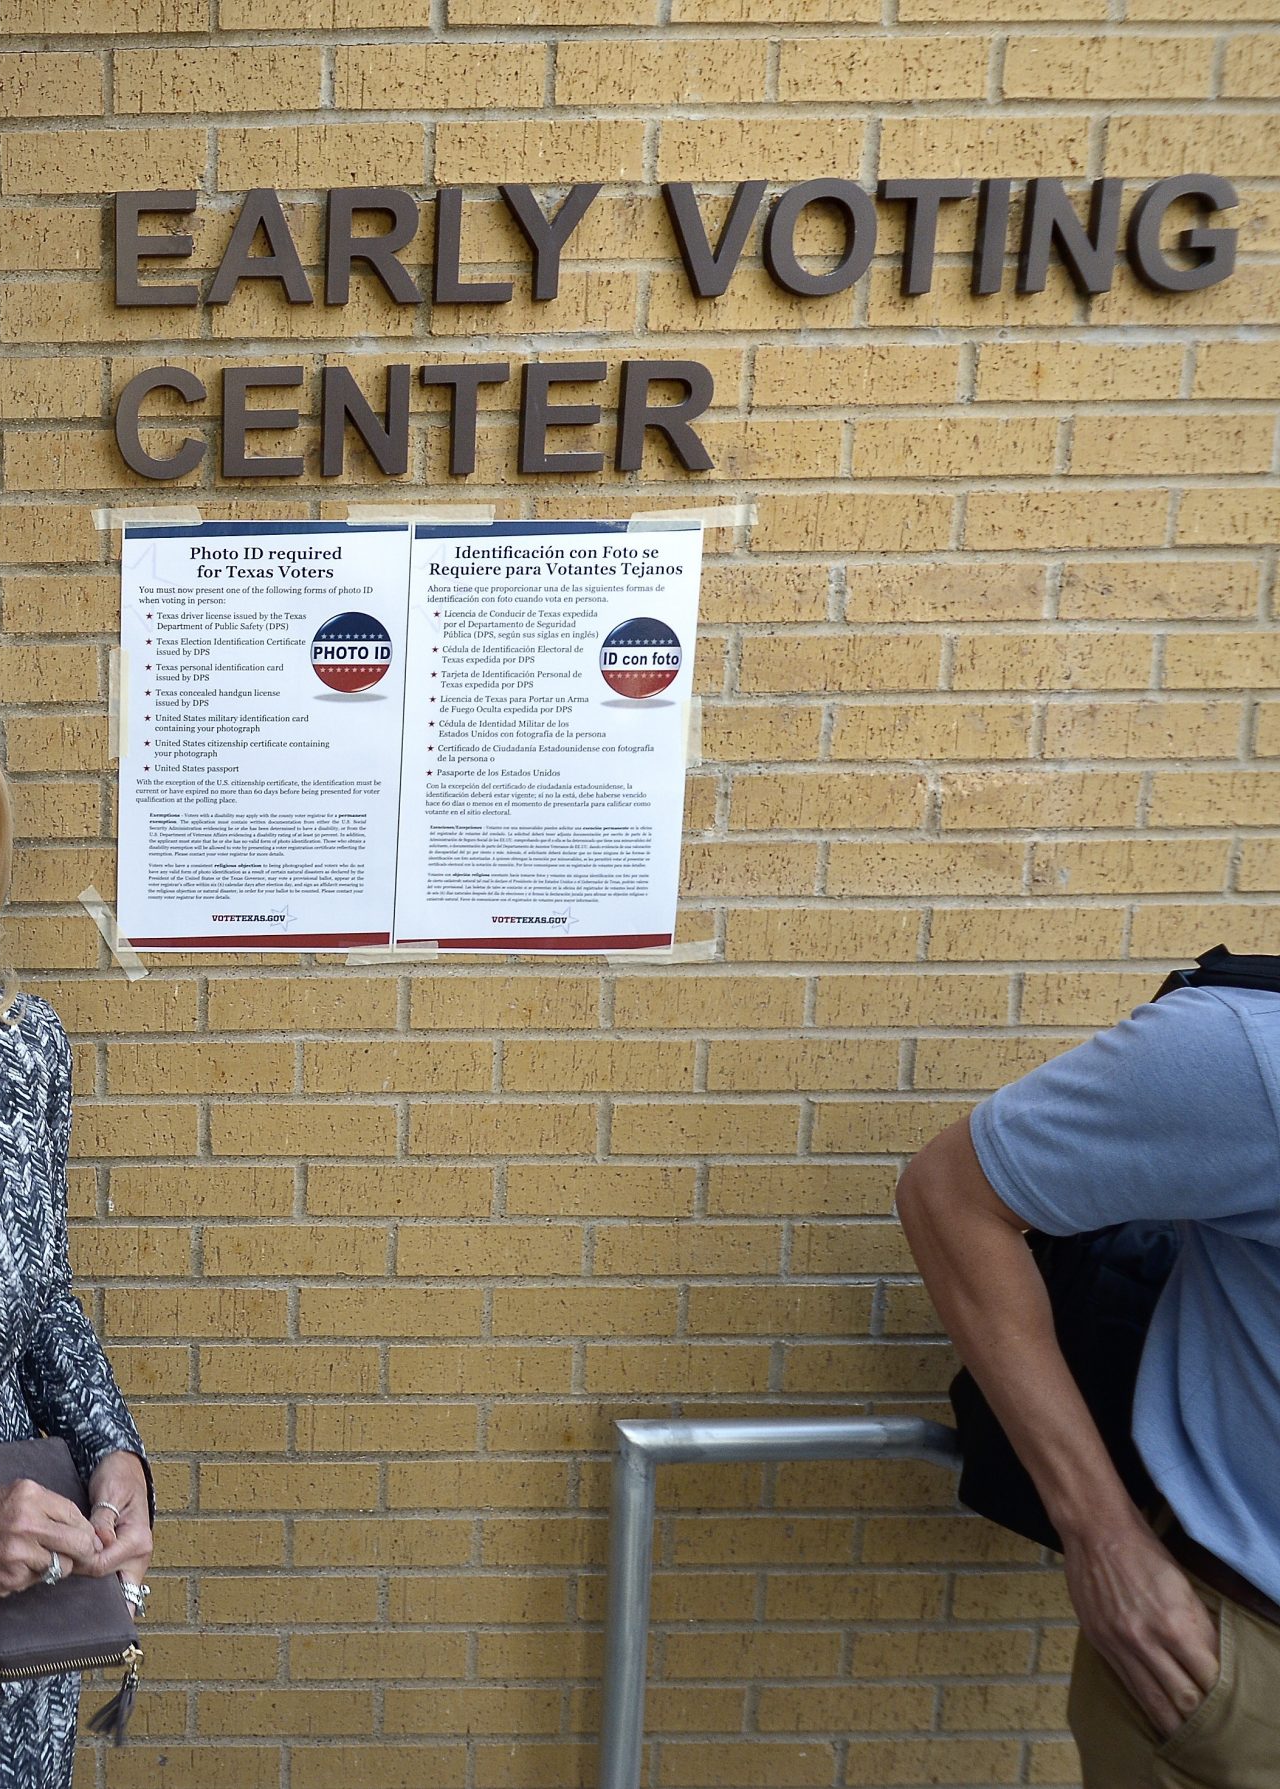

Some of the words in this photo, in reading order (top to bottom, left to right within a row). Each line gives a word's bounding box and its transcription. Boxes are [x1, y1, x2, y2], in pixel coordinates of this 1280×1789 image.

[116, 183, 604, 305] EARLY
[662, 173, 1240, 297] VOTING
[116, 361, 715, 479] CENTER
[189, 546, 239, 560] Photo
[243, 547, 264, 560] ID
[268, 546, 342, 563] required
[454, 545, 564, 559] Identificación
[569, 549, 597, 559] con
[602, 546, 638, 559] Foto
[642, 549, 659, 559] se
[197, 565, 222, 578] for
[225, 565, 274, 578] Texas
[277, 565, 334, 579] Voters
[429, 563, 501, 579] Requiere
[506, 566, 541, 579] para
[545, 563, 616, 575] Votantes
[620, 563, 683, 578] Tejanos
[139, 586, 154, 594] You
[195, 587, 224, 596] present
[241, 586, 251, 594] of
[251, 586, 264, 594] the
[266, 586, 303, 595] following
[303, 586, 327, 594] forms
[328, 586, 337, 594] of
[338, 586, 362, 596] photo
[363, 586, 374, 594] ID
[161, 597, 186, 606] voting
[197, 598, 226, 606] person:
[156, 612, 179, 620] Texas
[180, 612, 204, 620] driver
[205, 612, 232, 620] license
[233, 612, 257, 620] issued
[259, 612, 269, 622] by
[270, 612, 283, 620] the
[284, 612, 307, 620] Texas
[444, 610, 476, 618] Licencia
[478, 610, 488, 618] de
[489, 610, 526, 618] Conducir
[538, 610, 561, 618] Texas
[562, 610, 598, 619] expedida
[157, 623, 203, 632] Department
[240, 623, 264, 632] Safety
[265, 623, 289, 631] (DPS)
[443, 622, 458, 630] por
[525, 620, 535, 628] de
[536, 620, 576, 630] Seguridad
[443, 631, 472, 639] Pública
[473, 631, 496, 639] (DPS,
[497, 631, 521, 640] según
[537, 631, 559, 640] siglas
[572, 631, 599, 640] inglés)
[156, 638, 179, 646] Texas
[180, 638, 212, 646] Election
[214, 638, 265, 646] Identification
[266, 638, 306, 646] Certificate
[156, 648, 181, 656] issued
[182, 648, 192, 658] by
[193, 648, 210, 656] DPS
[313, 646, 369, 660] PHOTO
[374, 646, 391, 661] ID
[465, 656, 501, 665] expedida
[502, 657, 516, 665] por
[602, 652, 618, 666] ID
[622, 655, 647, 665] con
[652, 651, 680, 666] foto
[180, 664, 213, 673] personal
[182, 674, 192, 683] by
[441, 671, 469, 679] Tarjeta
[464, 681, 500, 690] expedida
[501, 682, 515, 690] por
[179, 689, 217, 697] concealed
[218, 689, 253, 698] handgun
[254, 689, 281, 697] license
[155, 699, 180, 707] issued
[181, 699, 191, 708] by
[192, 699, 209, 707] DPS
[451, 706, 475, 715] Fuego
[503, 706, 538, 715] expedida
[540, 707, 554, 715] por
[208, 715, 239, 724] military
[154, 725, 196, 733] containing
[196, 726, 215, 734] your
[216, 725, 261, 734] photograph
[207, 740, 249, 749] citizenship
[289, 740, 330, 749] containing
[154, 751, 173, 759] your
[173, 750, 218, 759] photograph
[206, 766, 239, 774] passport
[491, 916, 568, 924] VOTETEXAS.GOV
